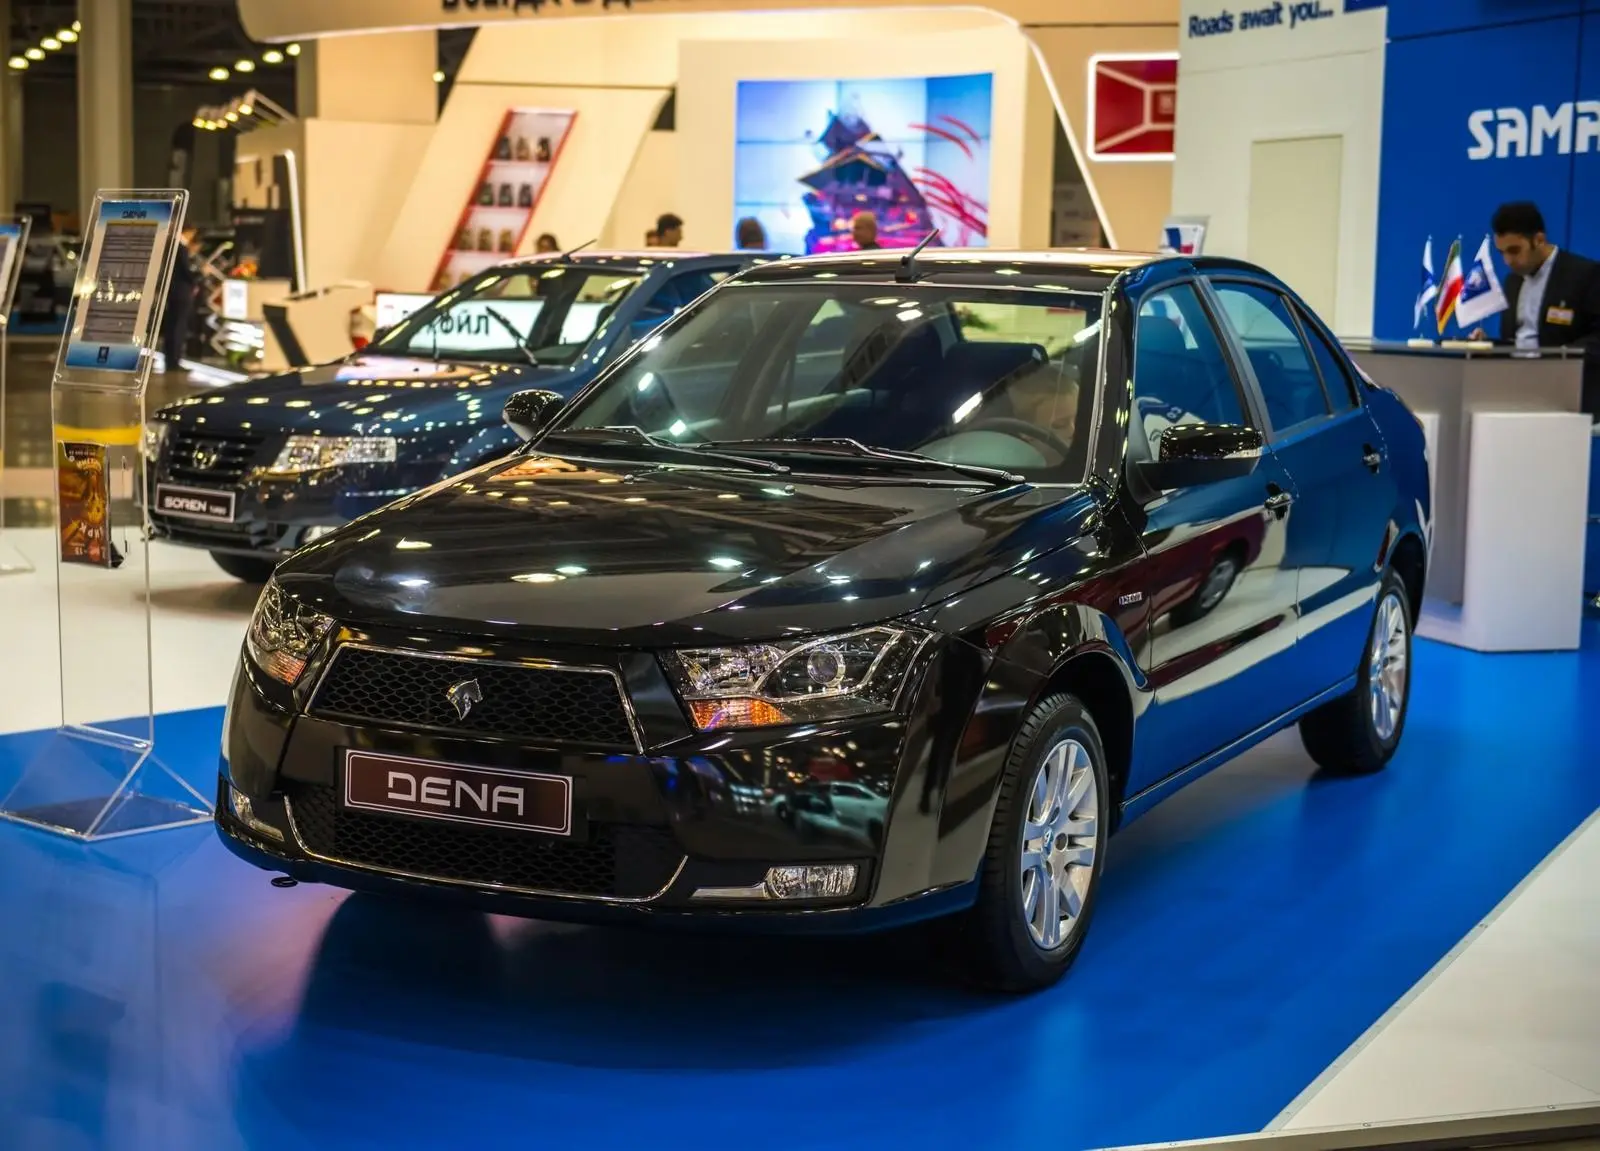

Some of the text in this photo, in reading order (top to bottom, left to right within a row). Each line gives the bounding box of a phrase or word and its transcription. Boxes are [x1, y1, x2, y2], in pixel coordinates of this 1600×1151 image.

[1188, 9, 1234, 38] Roads
[1239, 1, 1283, 31] await
[387, 770, 525, 817] DENA
